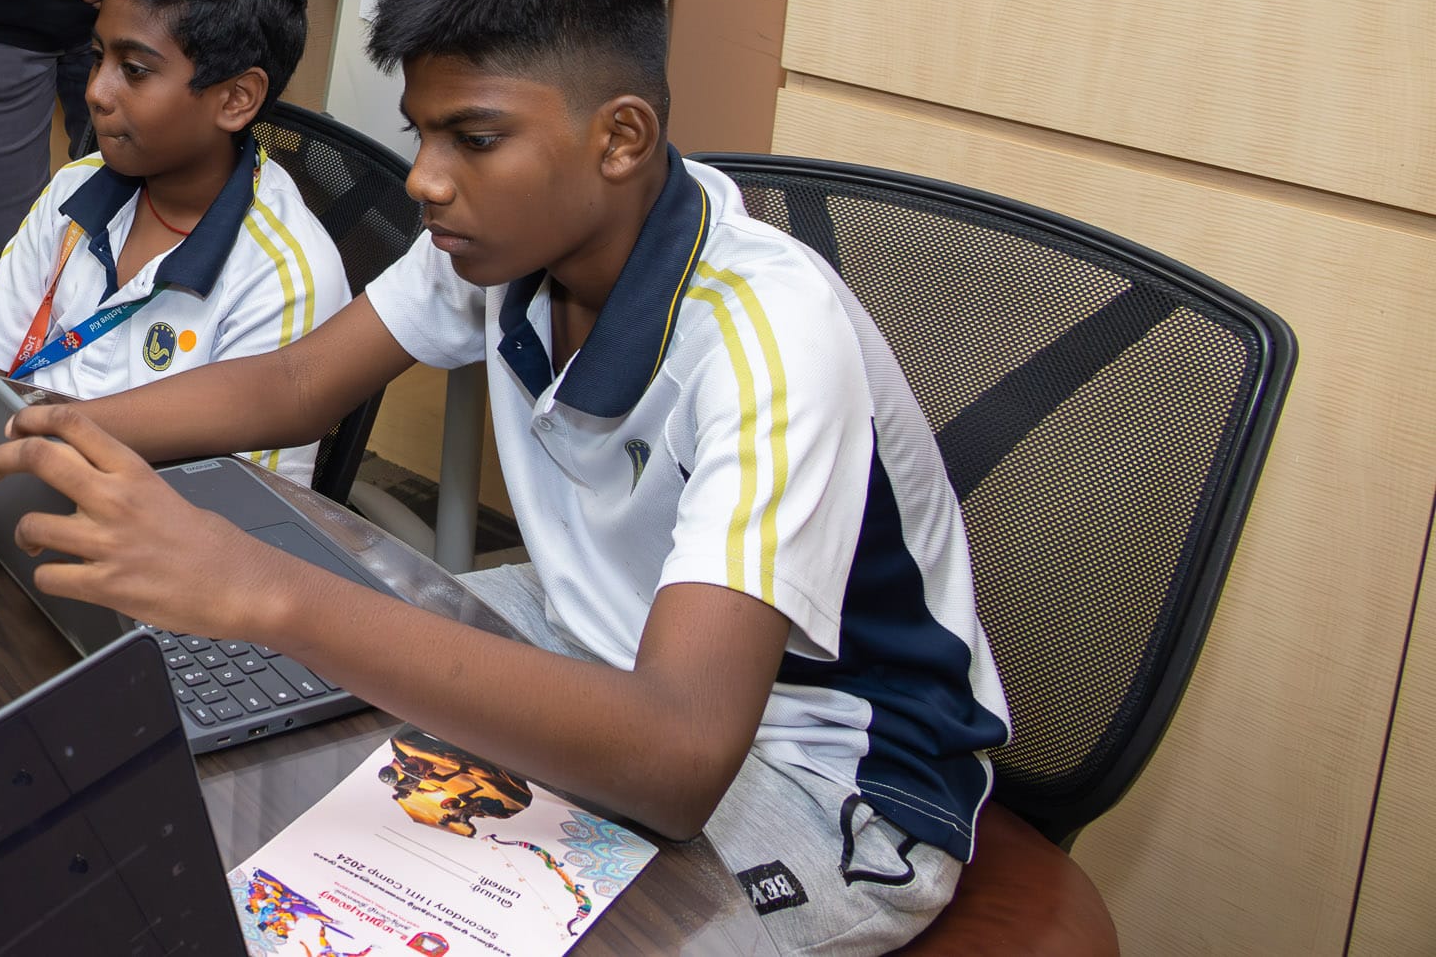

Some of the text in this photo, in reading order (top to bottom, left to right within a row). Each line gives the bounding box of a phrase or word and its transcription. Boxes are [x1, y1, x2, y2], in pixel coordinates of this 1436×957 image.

[89, 320, 103, 332] Kid
[99, 307, 124, 325] Active
[18, 336, 37, 362] Sport
[336, 853, 498, 939] Secondary 1 HTL Camp 2024
[751, 874, 796, 905] BEV
